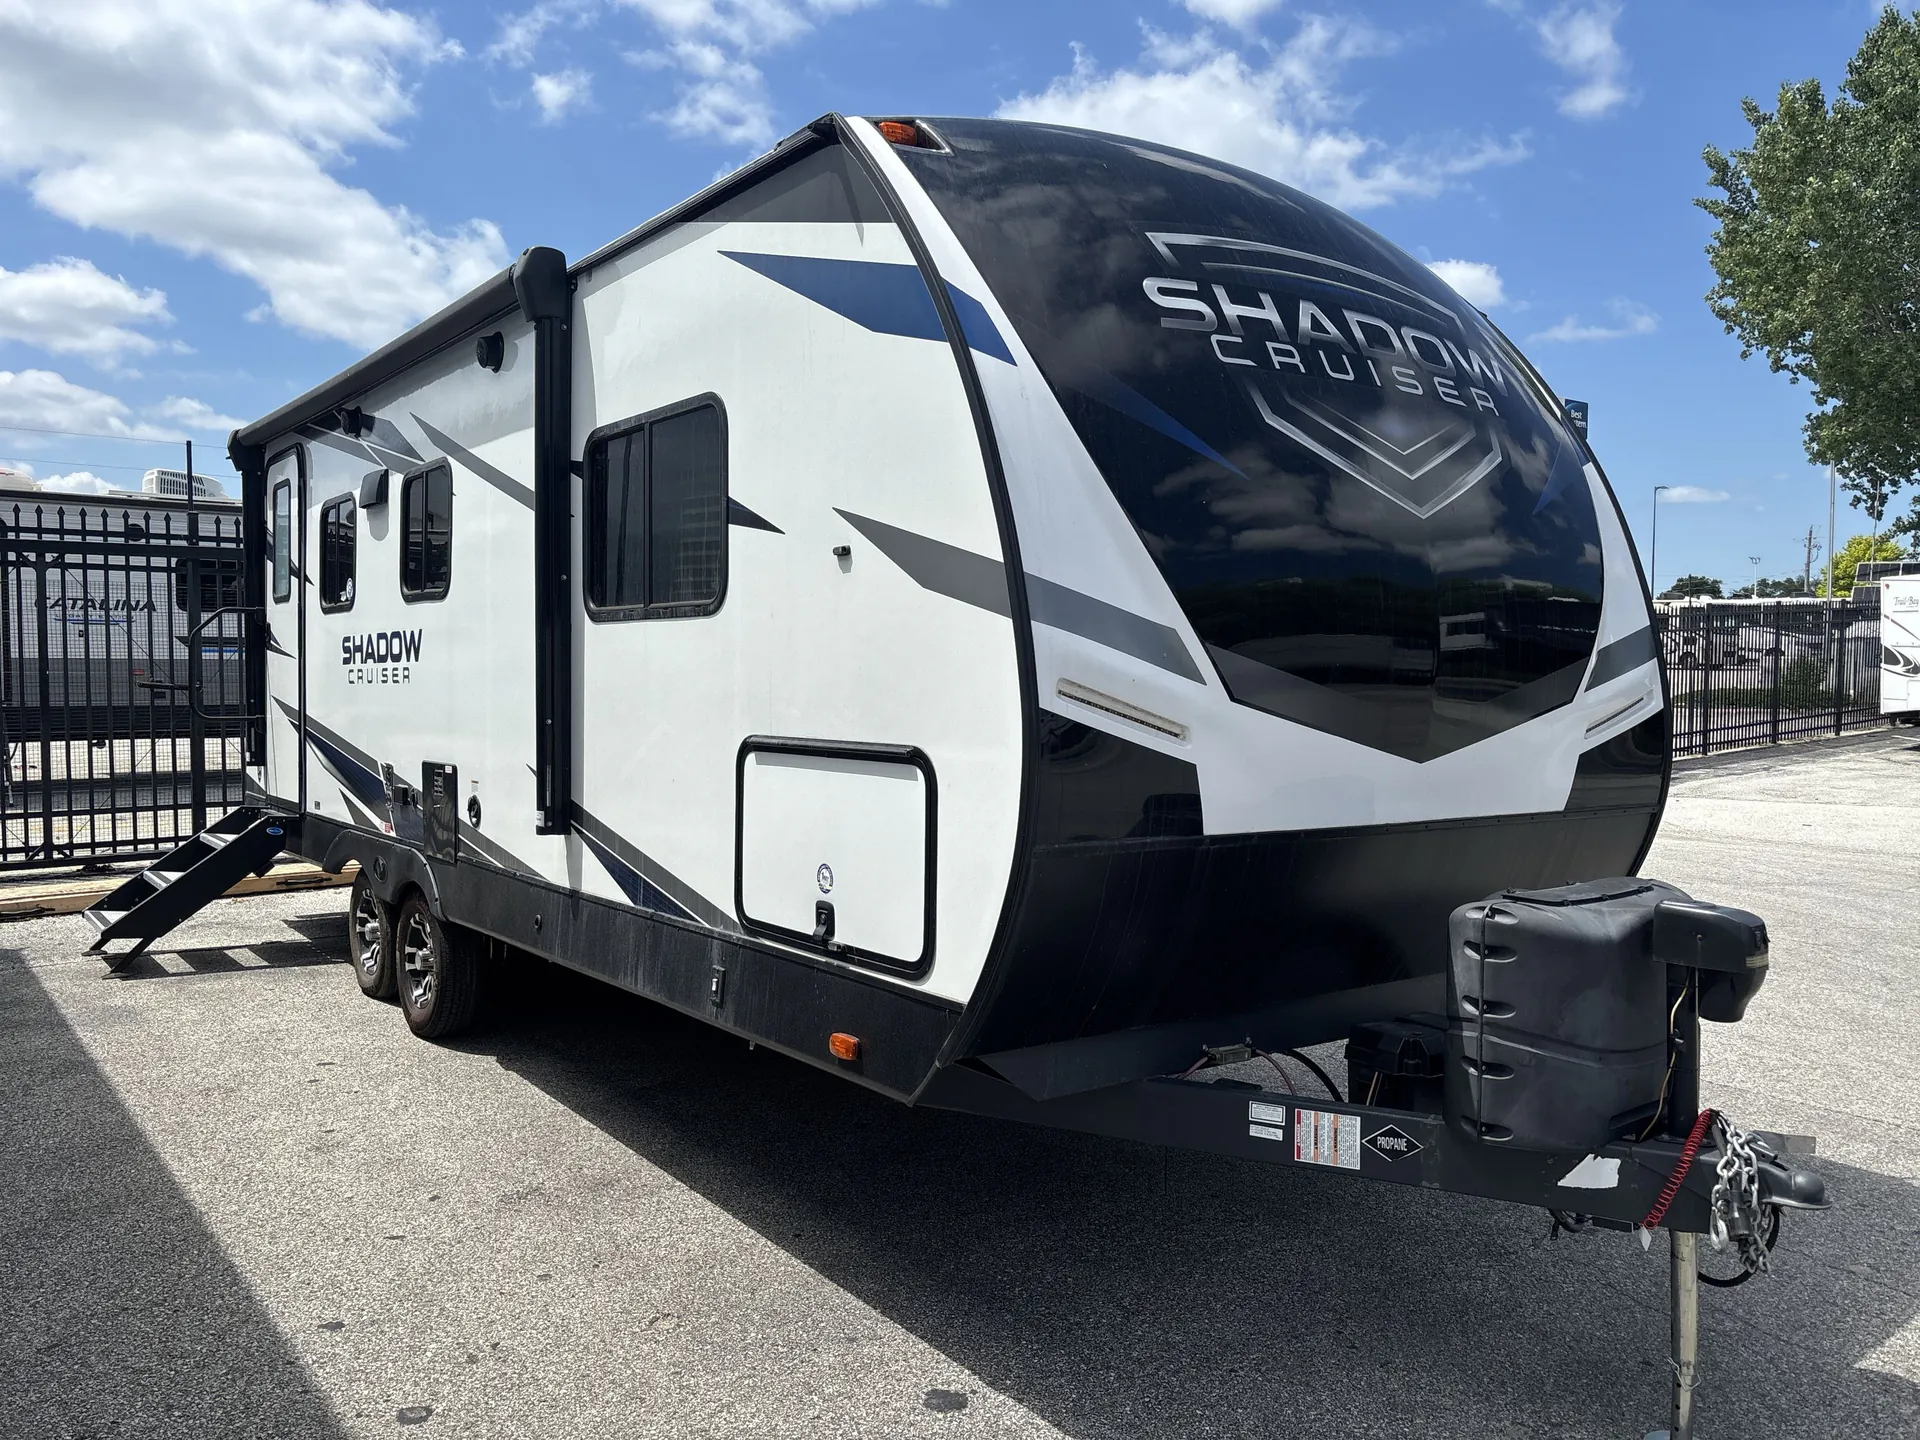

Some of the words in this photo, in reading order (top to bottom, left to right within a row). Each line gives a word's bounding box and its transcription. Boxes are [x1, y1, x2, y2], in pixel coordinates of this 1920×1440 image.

[1142, 277, 1509, 397] SHADOW
[1210, 334, 1500, 416] CRUISER
[1571, 409, 1582, 419] Best
[342, 628, 423, 665] SHADOW
[348, 666, 411, 684] CRUISER
[1377, 1136, 1408, 1151] PROPANE
